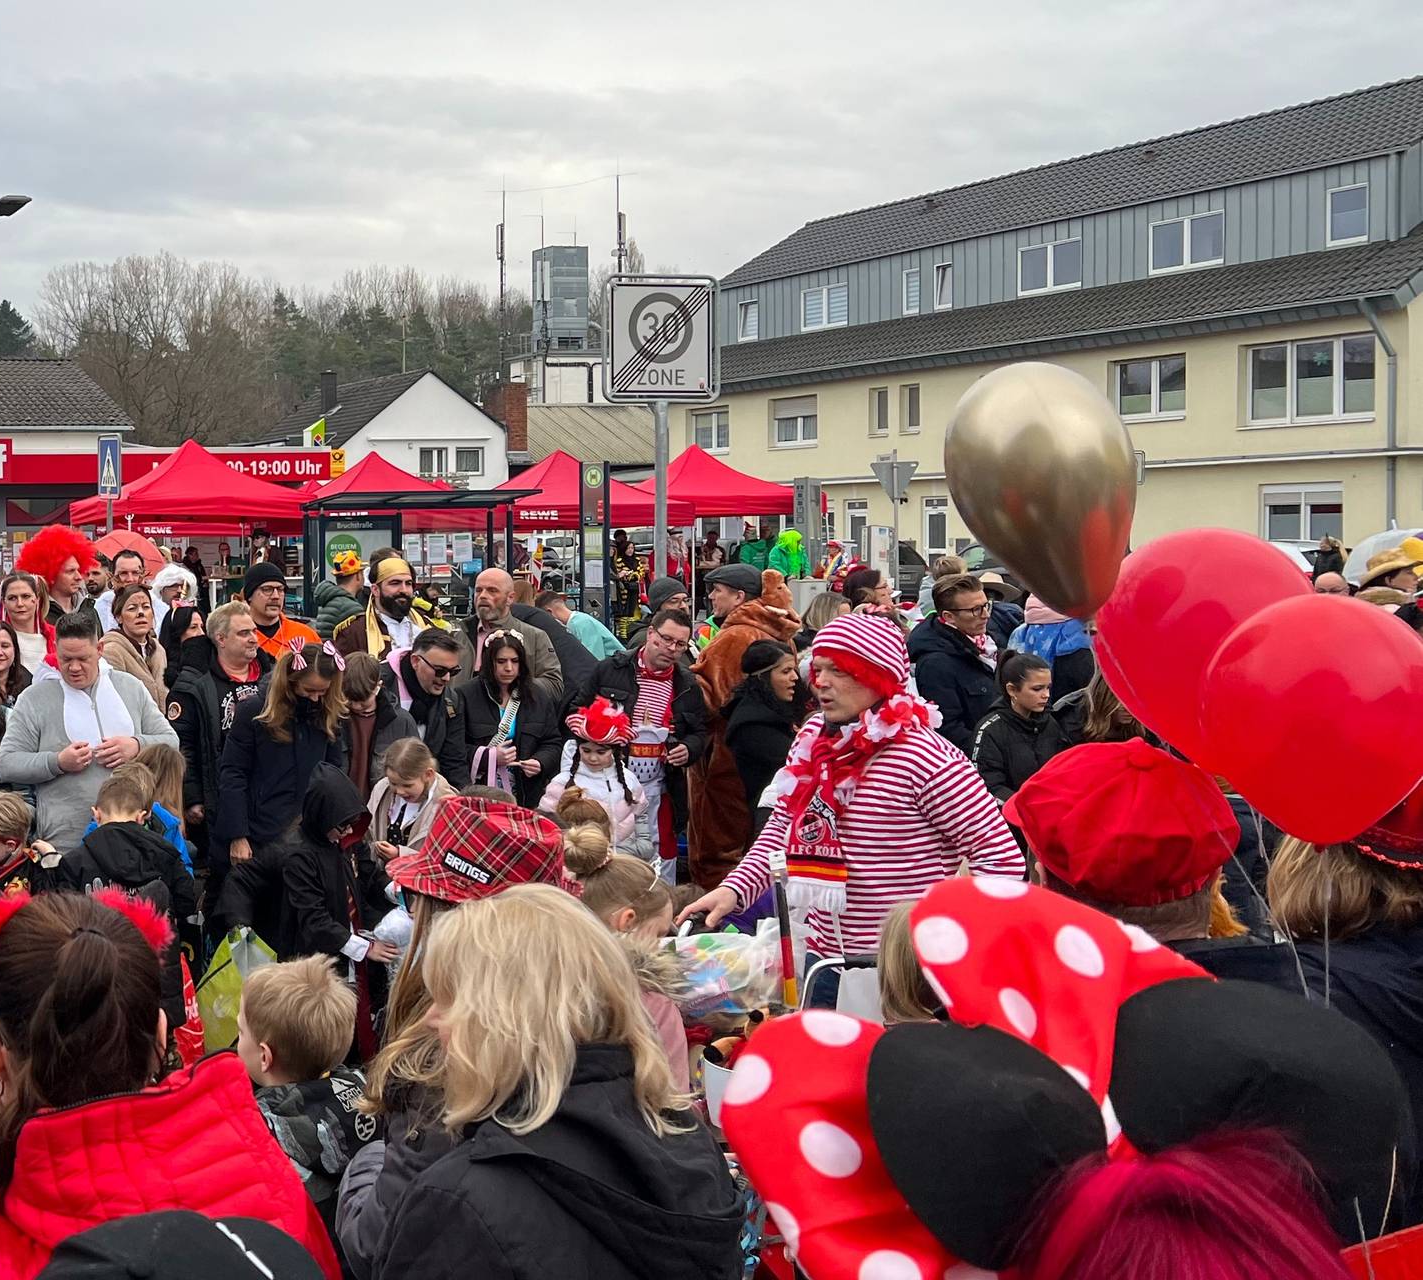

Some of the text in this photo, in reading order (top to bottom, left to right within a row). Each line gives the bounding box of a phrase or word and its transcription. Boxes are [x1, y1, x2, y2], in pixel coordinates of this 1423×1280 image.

[642, 312, 679, 344] 30
[637, 369, 685, 386] ZONE
[295, 460, 322, 475] Uhr
[519, 510, 559, 520] REWE
[143, 526, 173, 535] REWE
[444, 852, 491, 884] BRINGS
[337, 1086, 363, 1104] NORTH
